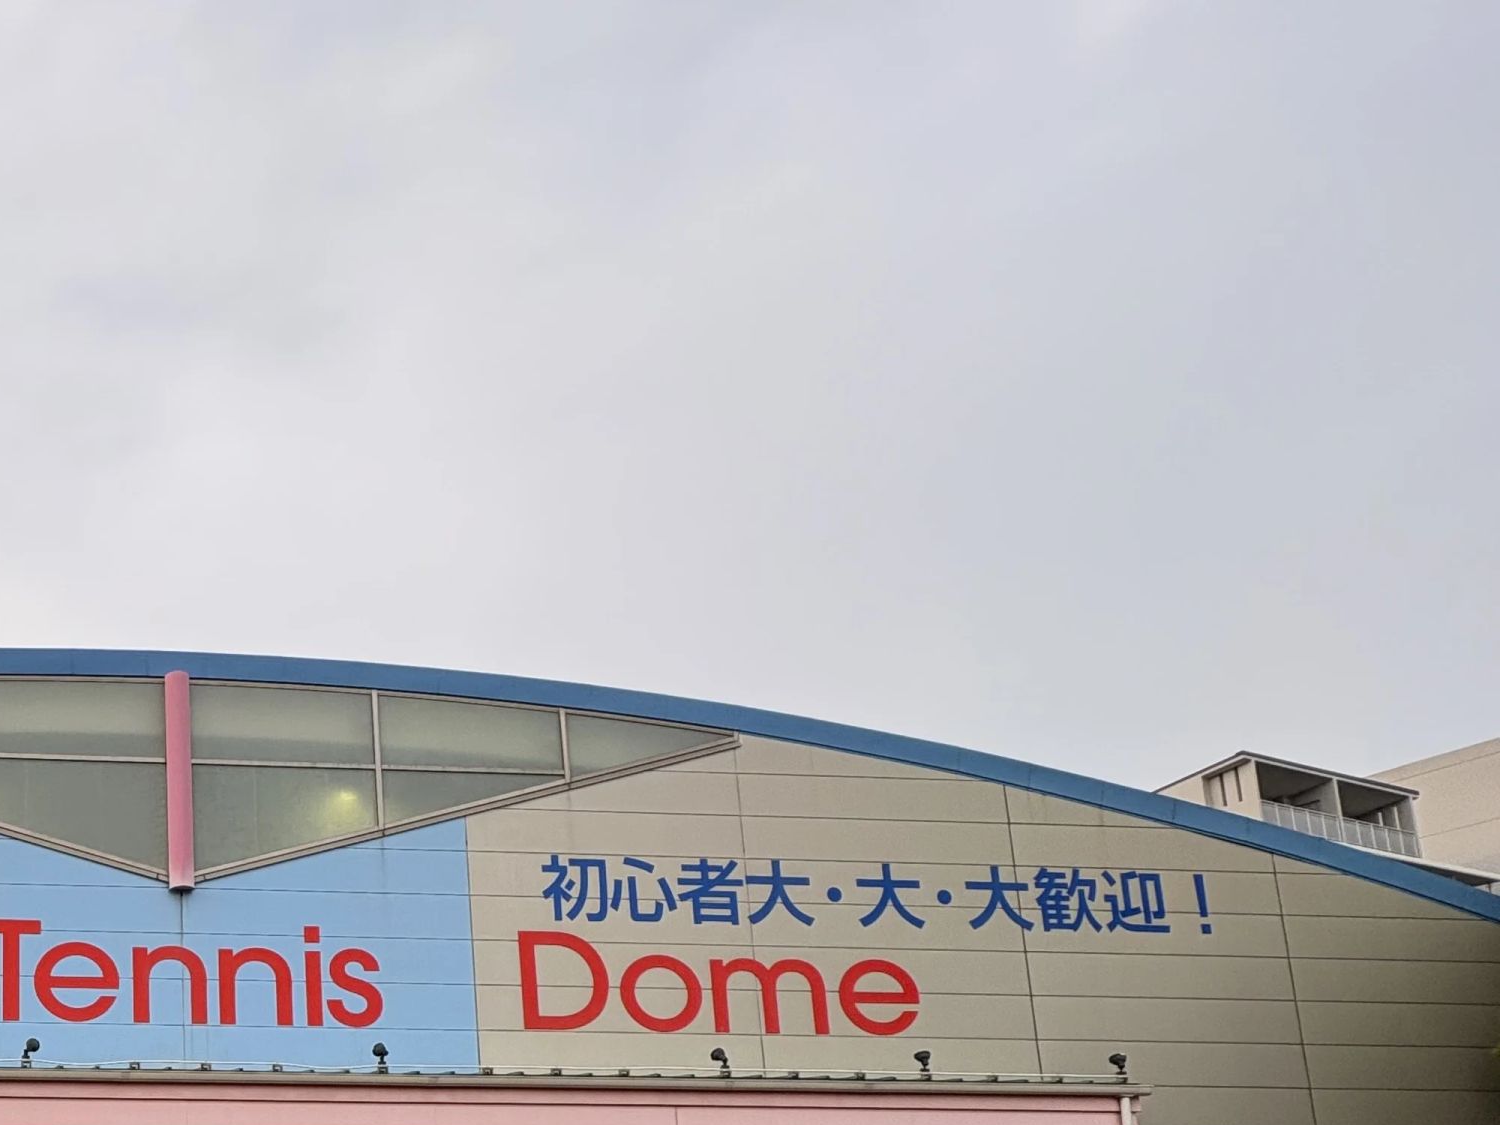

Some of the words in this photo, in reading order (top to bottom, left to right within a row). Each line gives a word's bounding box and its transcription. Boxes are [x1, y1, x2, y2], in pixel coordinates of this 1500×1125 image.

[542, 855, 1212, 936] 初心者大・大・大歓迎！
[518, 931, 920, 1036] Dome
